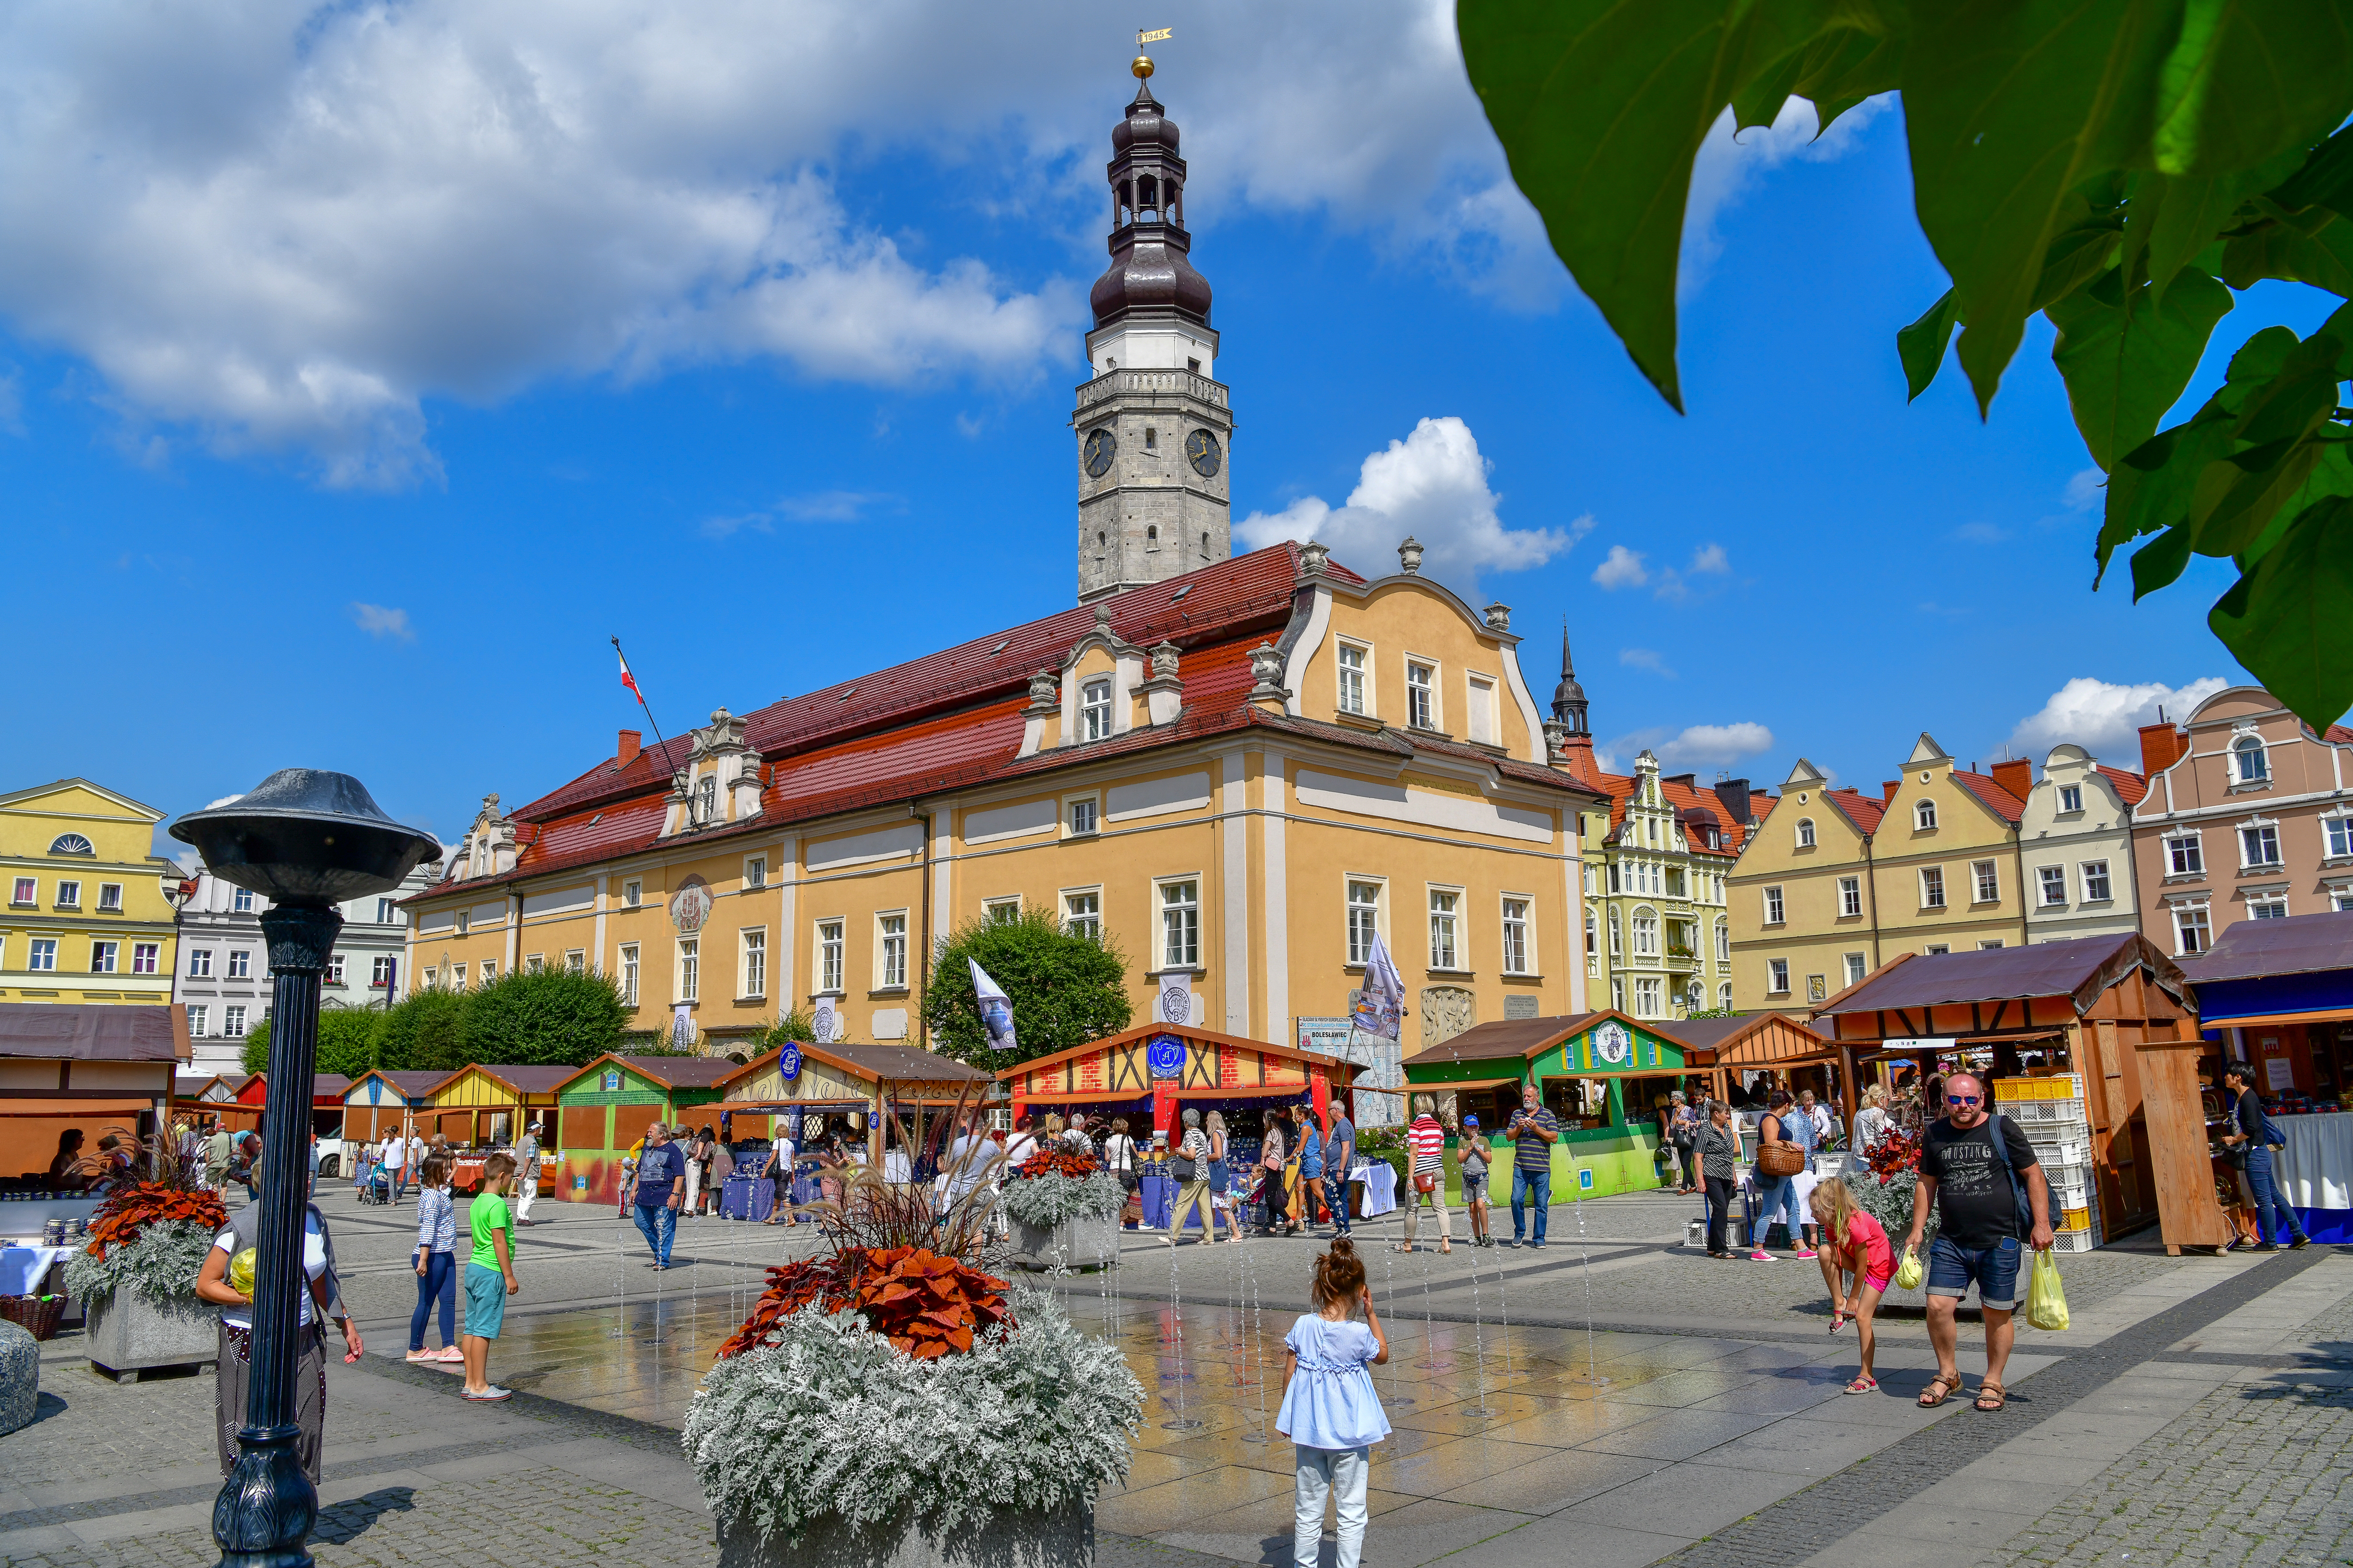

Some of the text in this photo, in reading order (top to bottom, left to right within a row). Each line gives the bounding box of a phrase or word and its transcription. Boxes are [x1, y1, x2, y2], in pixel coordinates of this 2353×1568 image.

[1144, 31, 1164, 41] 1945
[1164, 989, 1189, 1020] CERAMIKA BOLESŁAWIECKA
[1173, 1011, 1180, 1021] B
[1597, 1022, 1613, 1037] CERAMIKA
[1155, 1036, 1178, 1044] ARKADIA
[1161, 1051, 1170, 1062] A
[1941, 1145, 1992, 1159] MUSTANG
